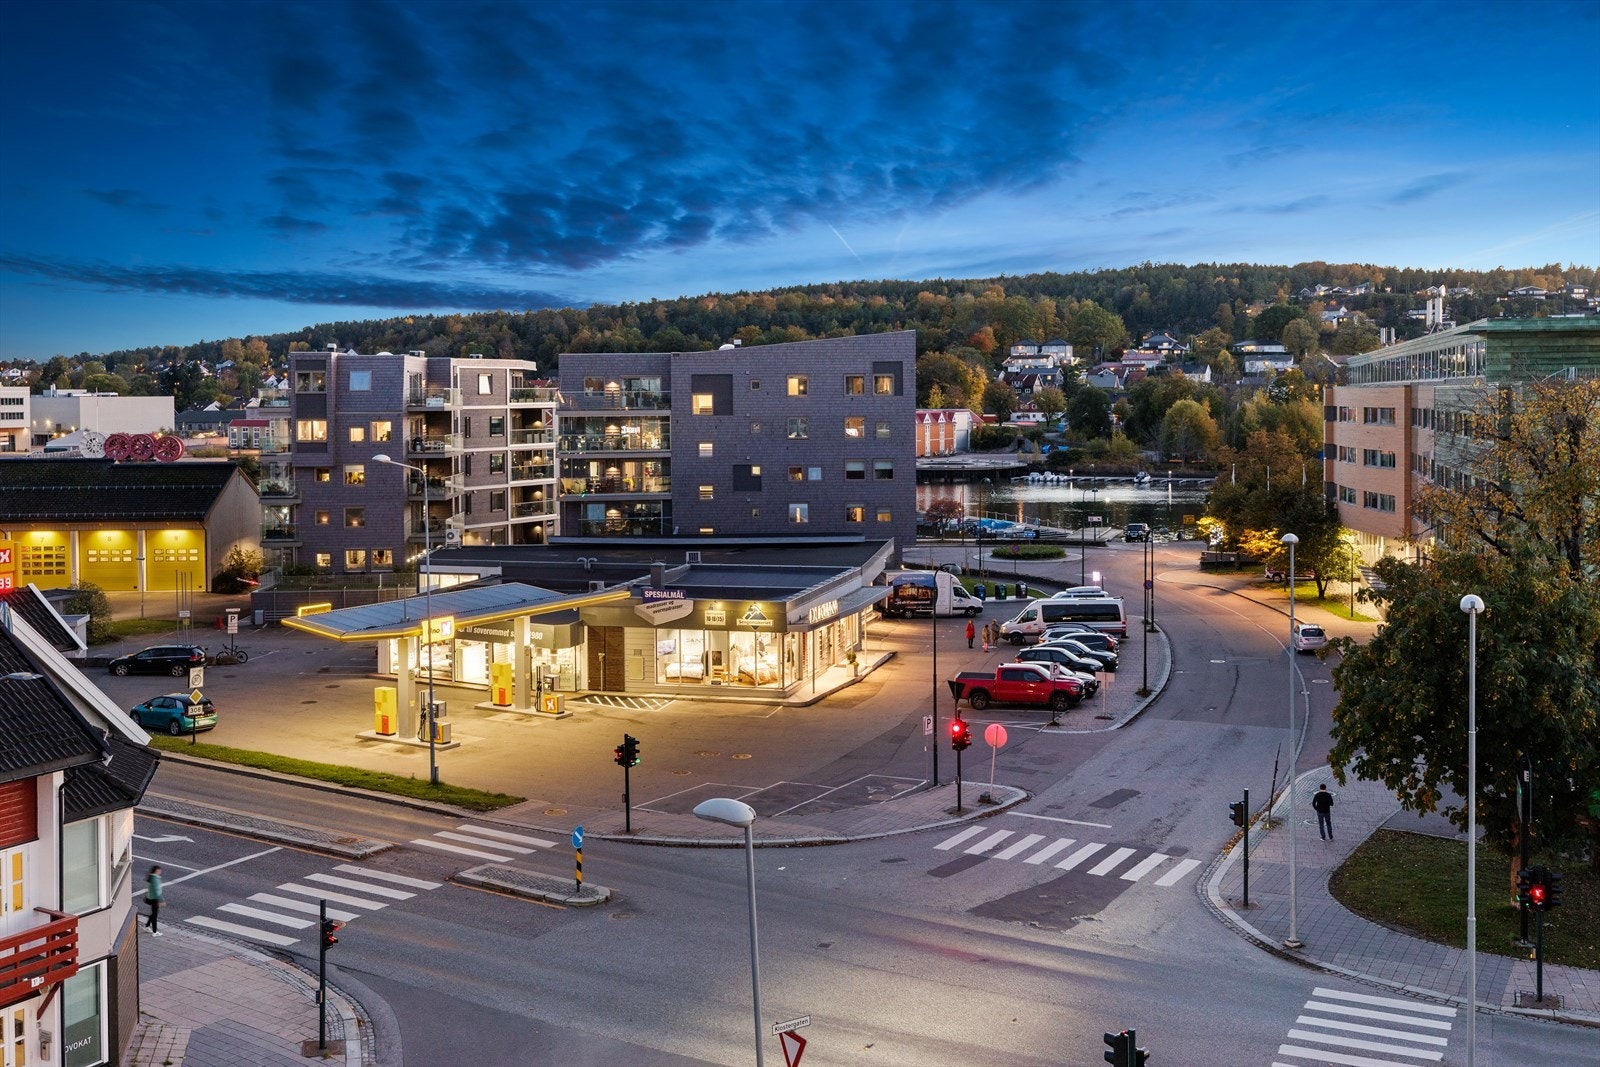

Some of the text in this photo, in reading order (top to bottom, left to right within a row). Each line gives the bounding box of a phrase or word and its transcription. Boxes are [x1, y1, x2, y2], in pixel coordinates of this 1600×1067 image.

[644, 590, 685, 599] SPESIALMÅL
[473, 627, 510, 637] soverommet
[775, 1019, 809, 1032] Klostergaten
